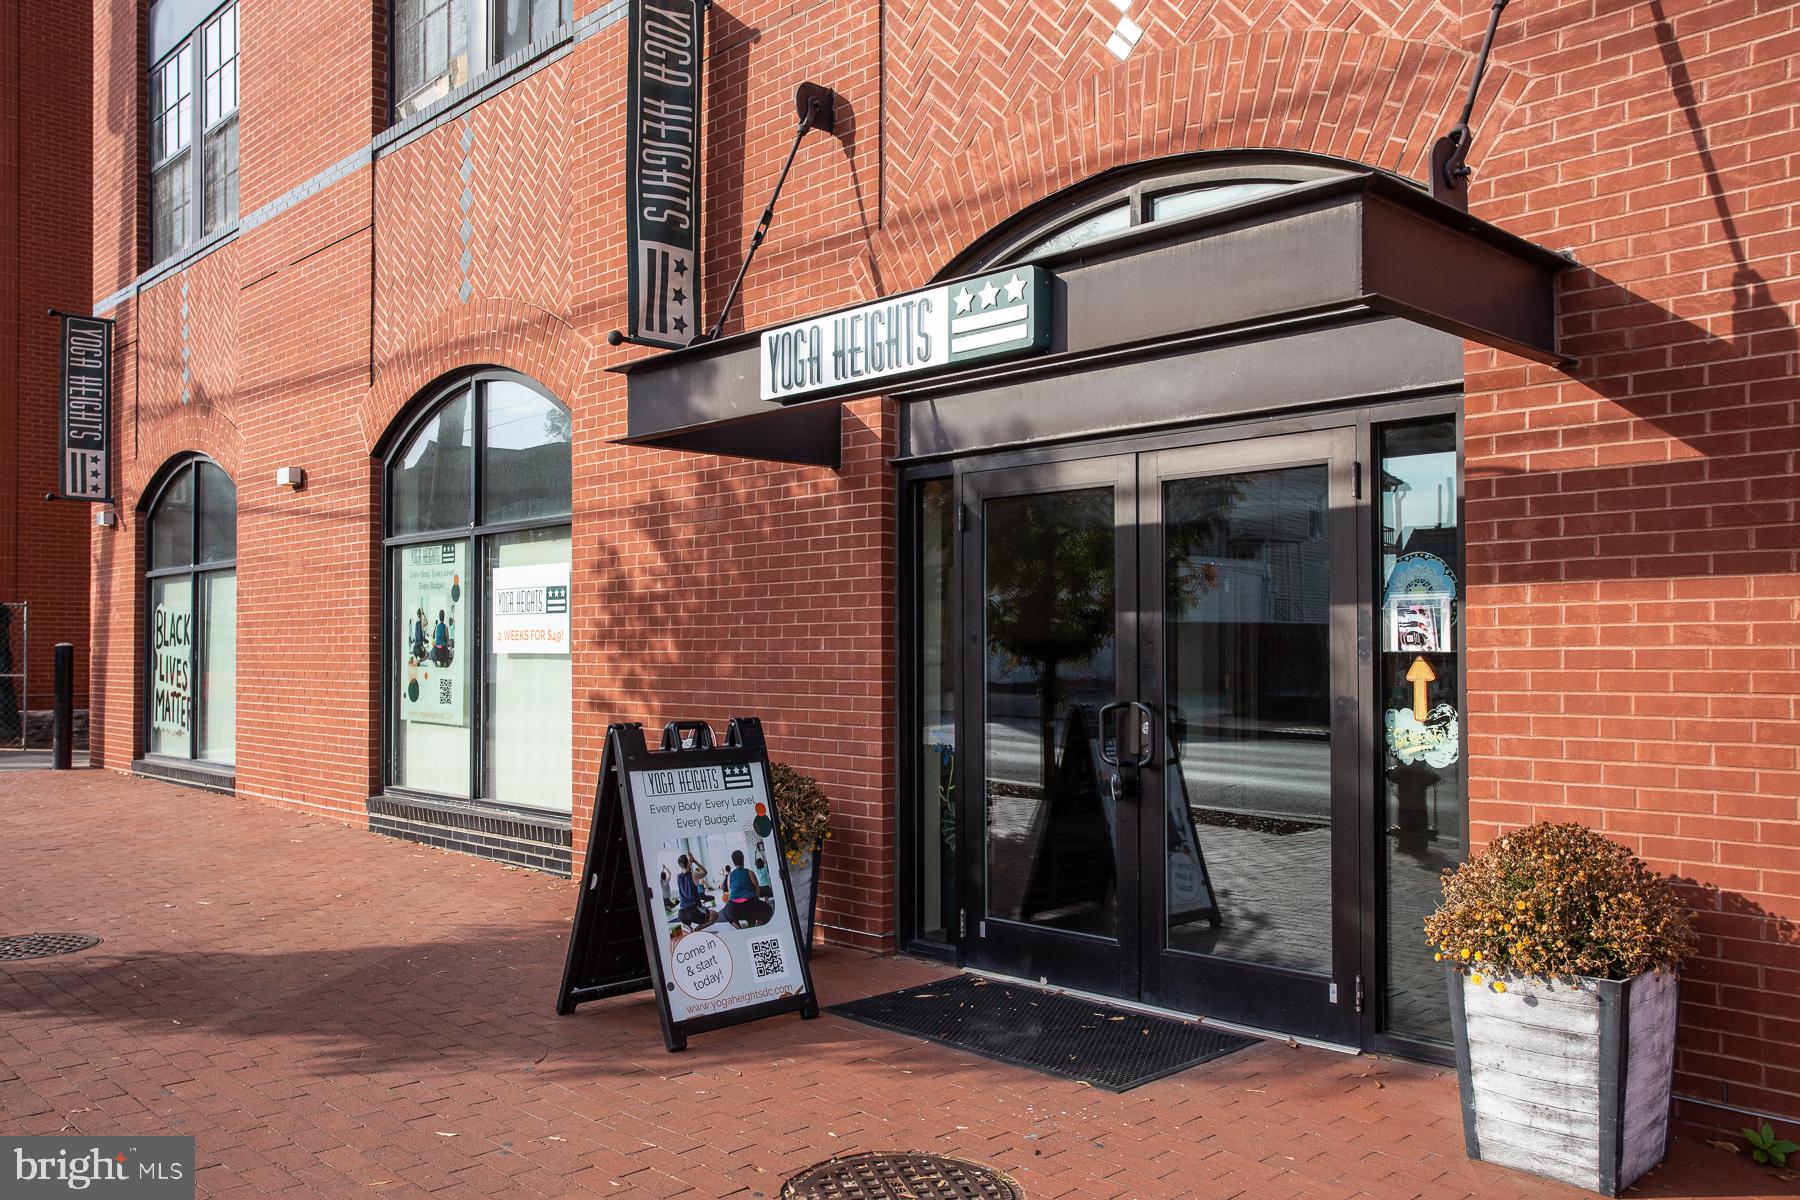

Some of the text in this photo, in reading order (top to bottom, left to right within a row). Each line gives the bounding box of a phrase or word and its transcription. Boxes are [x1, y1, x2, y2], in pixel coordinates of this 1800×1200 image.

[642, 4, 692, 230] YOGA HEIGHTS
[768, 297, 933, 394] YOGA HEIGHTS
[69, 329, 103, 441] YOGA HEIGHTS
[498, 589, 542, 613] YOGA HEIGHTS
[156, 609, 191, 650] BLACK
[497, 628, 564, 643] 2 WEEKS FOR $49!
[159, 653, 188, 692] LIVES
[647, 767, 719, 794] YOGA HEIGHTS
[649, 804, 676, 814] Every
[705, 799, 730, 809] Every
[676, 818, 702, 829] Every
[676, 939, 717, 964] Come in
[686, 954, 719, 977] & start
[693, 968, 724, 991] today!
[686, 983, 794, 1014] www.yogaheightsdc.com
